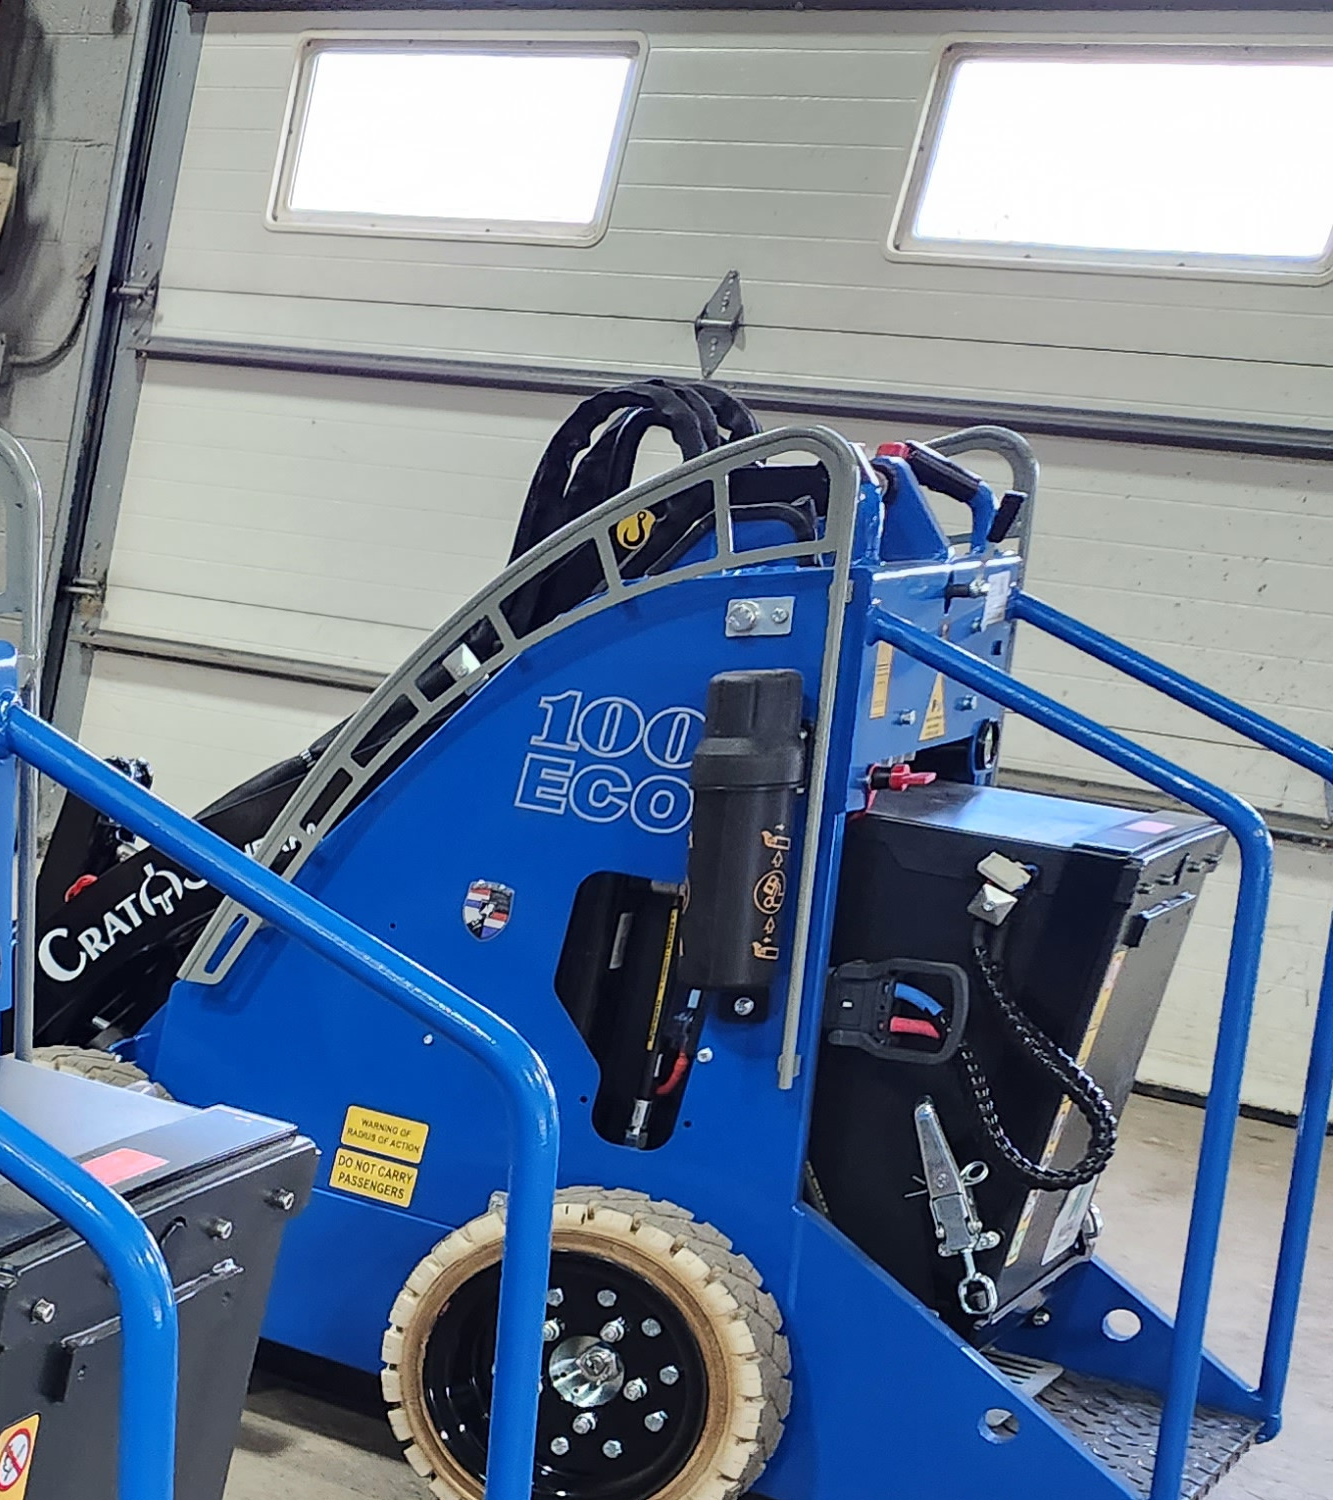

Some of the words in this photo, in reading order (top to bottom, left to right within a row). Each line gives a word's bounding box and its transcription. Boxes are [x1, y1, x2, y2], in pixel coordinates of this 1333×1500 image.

[529, 690, 708, 770] 100
[513, 752, 695, 834] ECO
[37, 862, 209, 982] CRATO
[347, 1127, 376, 1142] RADIUS
[377, 1136, 390, 1145] OF
[390, 1140, 421, 1154] ACTION
[361, 1119, 399, 1135] WARNING
[400, 1128, 412, 1137] OF
[338, 1155, 353, 1169] DO
[356, 1159, 377, 1175] NOT
[378, 1165, 414, 1185] CARRY
[338, 1171, 405, 1199] PASSENGERS
